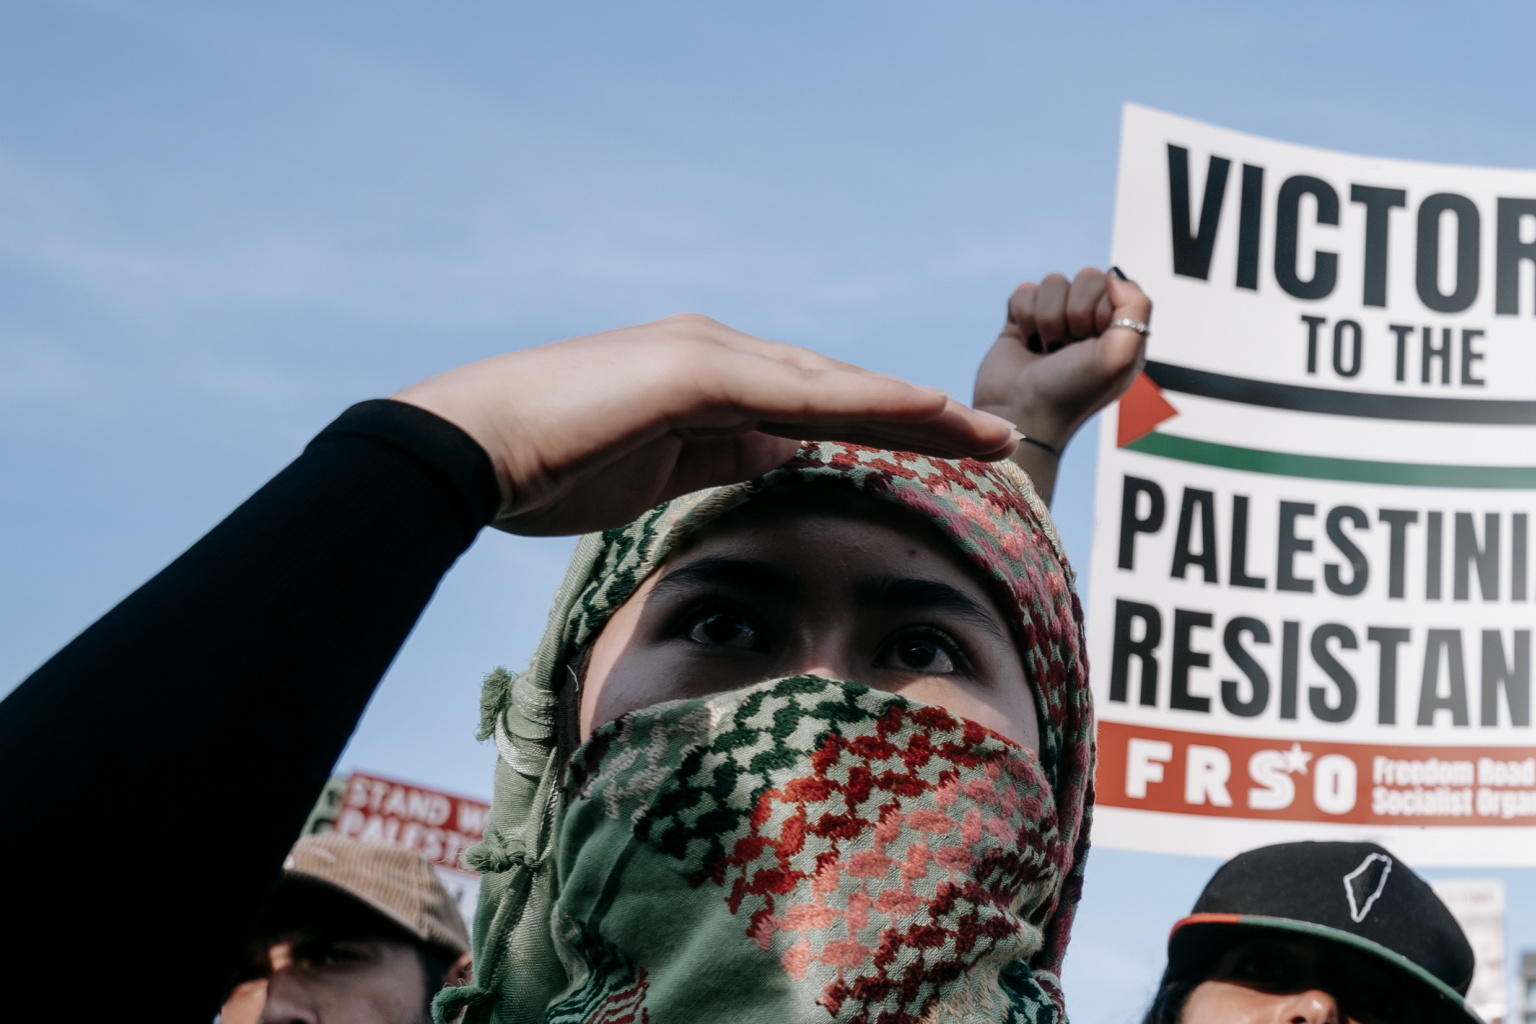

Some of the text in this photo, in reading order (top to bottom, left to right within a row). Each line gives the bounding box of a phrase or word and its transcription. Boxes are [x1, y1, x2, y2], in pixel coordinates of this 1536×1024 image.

[1301, 316, 1486, 386] TO THE
[347, 776, 452, 828] STAND
[1125, 738, 1536, 815] FRSO Freedom Road
[1372, 786, 1473, 816] Socialist
